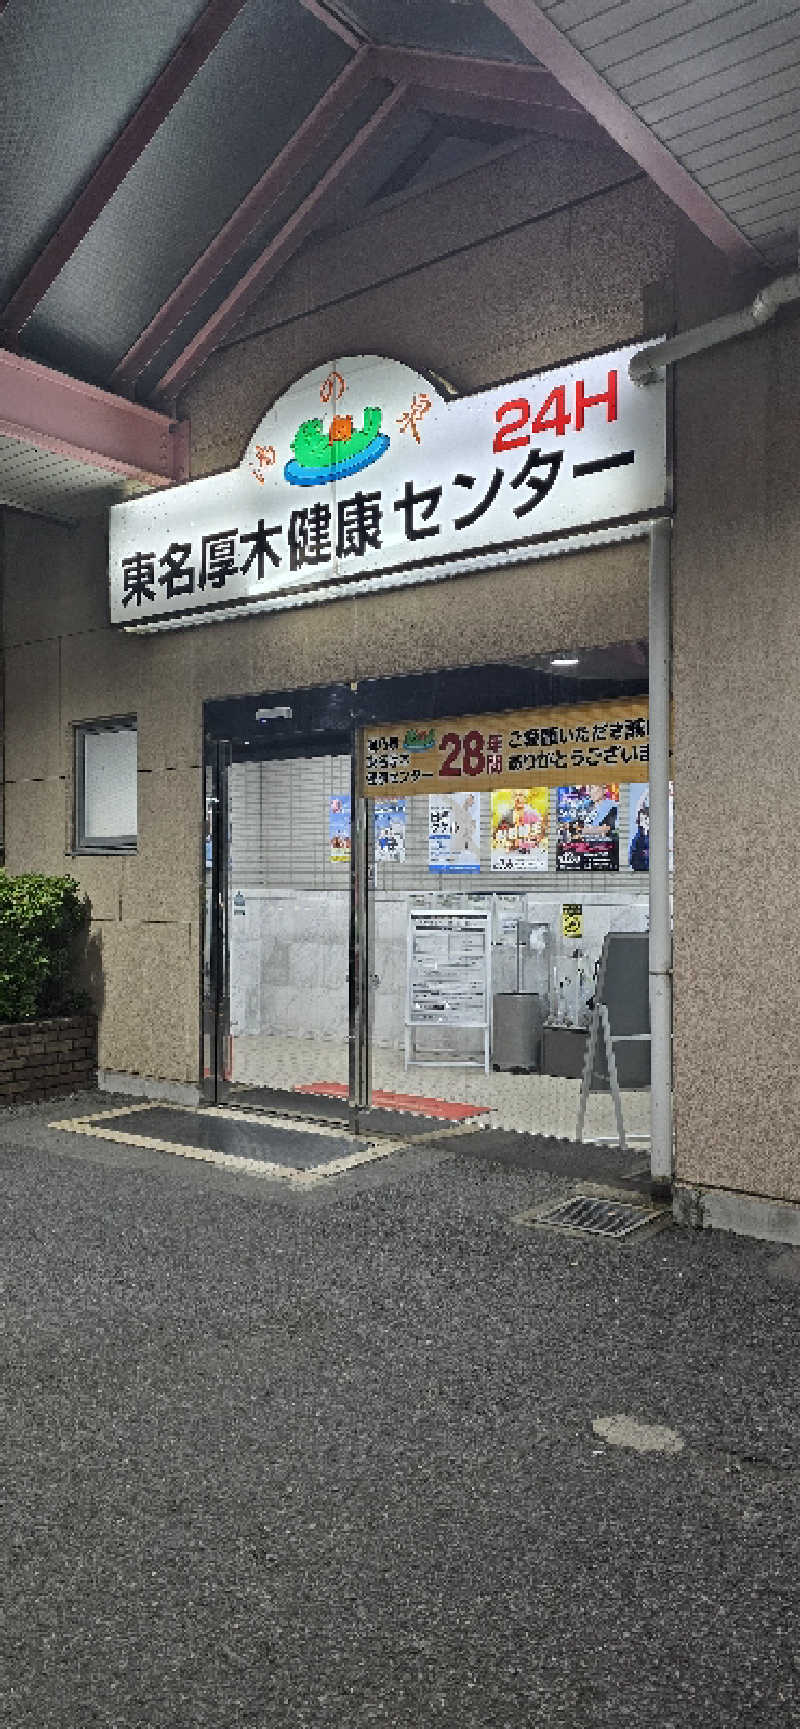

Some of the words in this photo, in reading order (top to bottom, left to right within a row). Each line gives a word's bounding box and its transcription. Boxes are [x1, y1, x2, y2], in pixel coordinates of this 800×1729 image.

[493, 370, 617, 454] 24H
[121, 450, 634, 608] 東名厚木健康センター
[439, 731, 485, 776] 28
